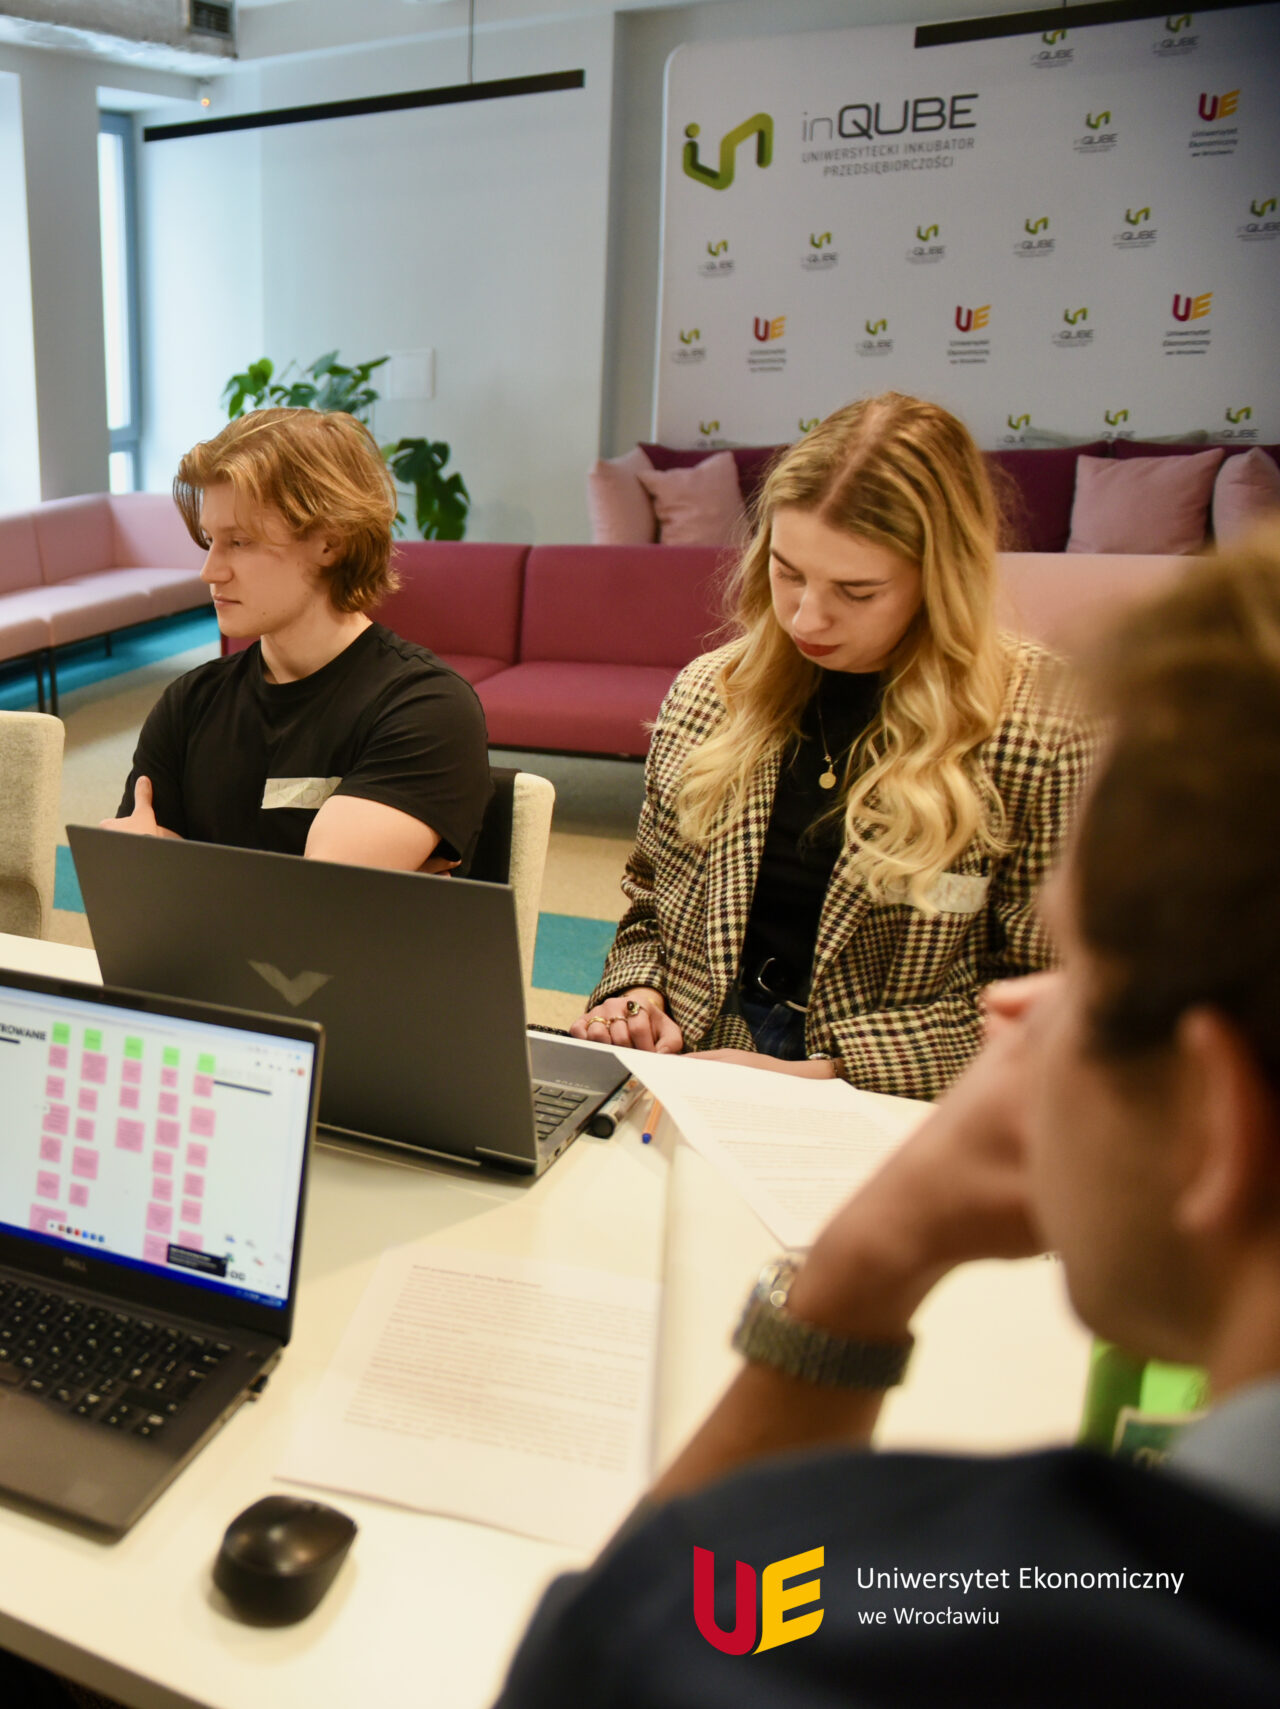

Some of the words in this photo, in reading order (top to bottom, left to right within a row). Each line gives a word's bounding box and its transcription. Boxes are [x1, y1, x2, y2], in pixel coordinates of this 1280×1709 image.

[802, 93, 979, 142] inQUBE
[802, 143, 901, 164] UNIWERSYTECKI
[904, 138, 976, 155] INKUBATOR
[823, 155, 954, 177] PRZEDSIĘBIORCZOŚCI
